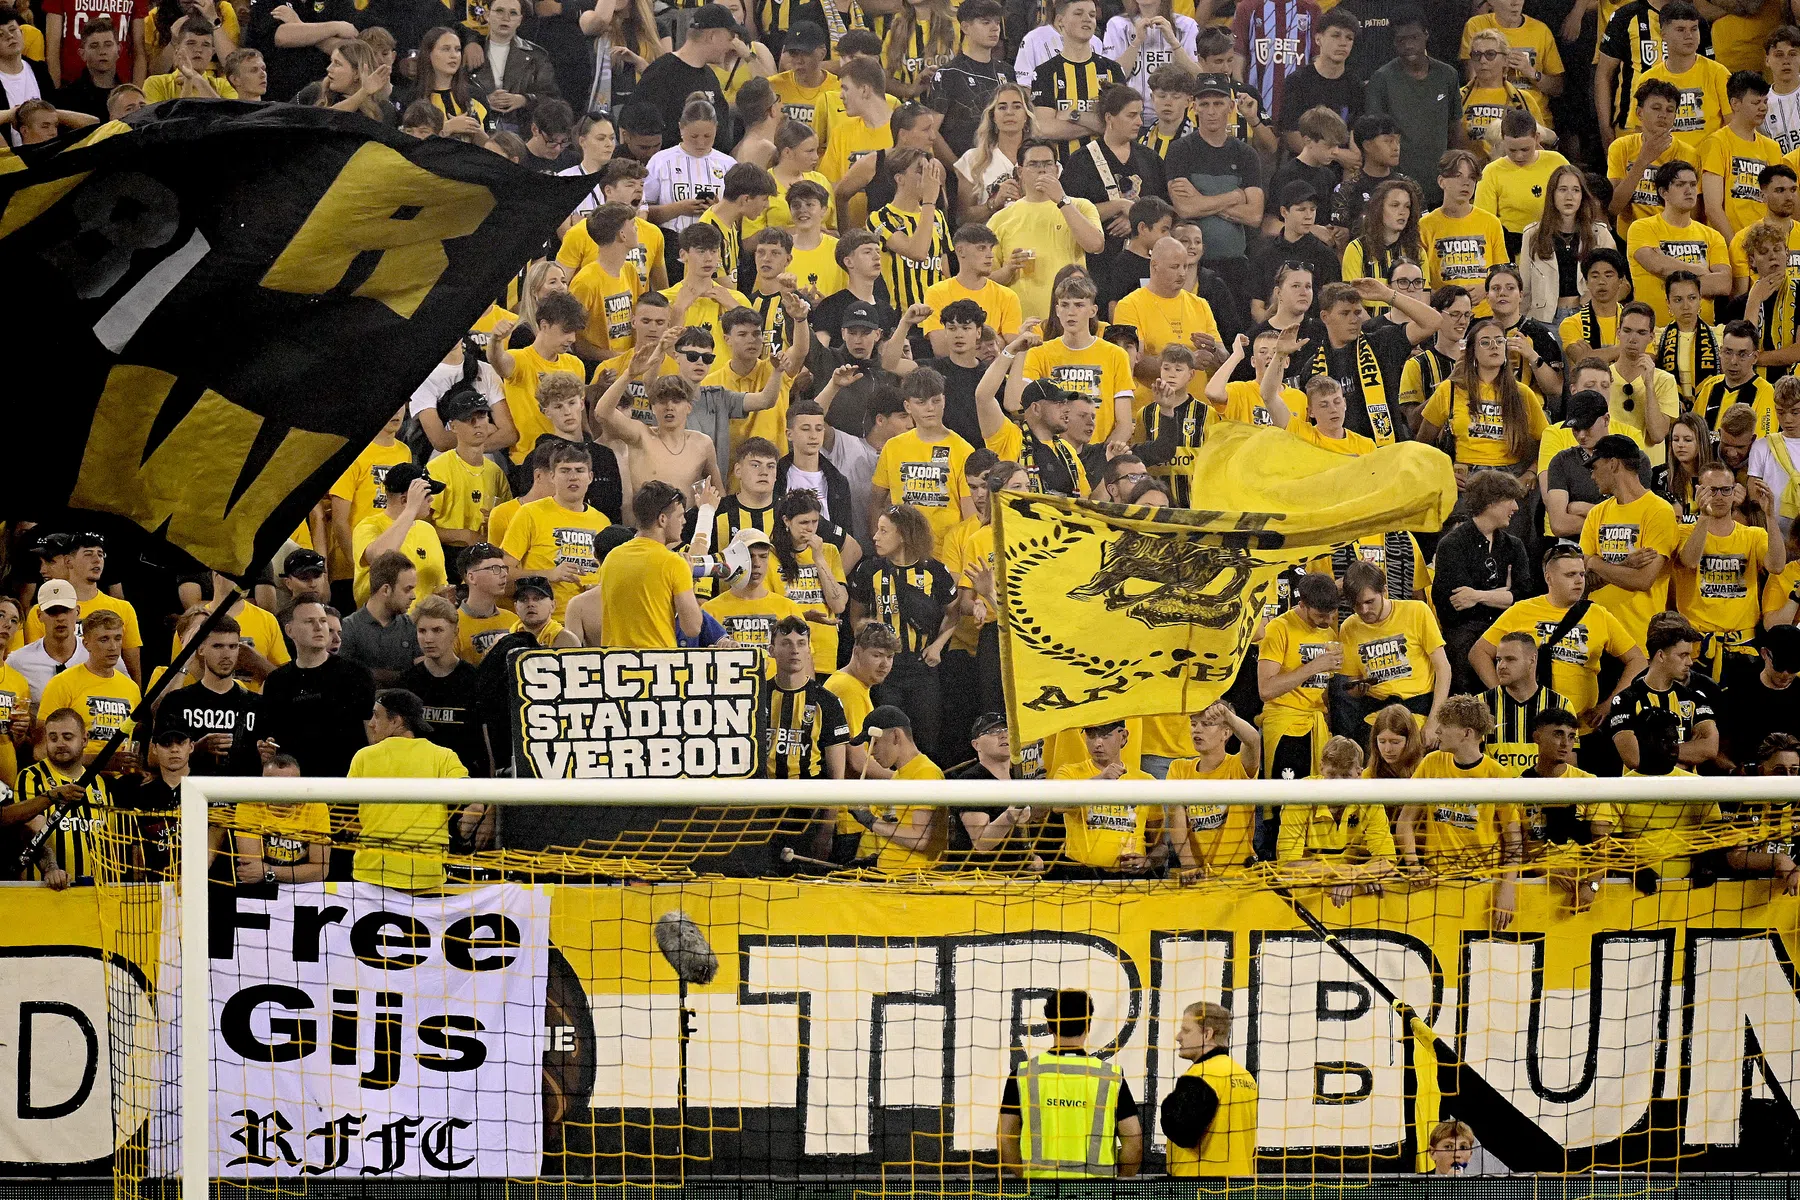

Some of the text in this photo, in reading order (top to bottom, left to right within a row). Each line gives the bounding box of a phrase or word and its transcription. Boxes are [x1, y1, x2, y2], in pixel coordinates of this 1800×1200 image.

[63, 12, 131, 42] ICN
[1273, 38, 1301, 51] BET
[1273, 51, 1305, 66] CITY
[788, 105, 812, 120] VOO
[1077, 100, 1099, 112] BE
[1632, 191, 1658, 202] ZWAR
[1443, 239, 1479, 253] VOOR
[1667, 244, 1700, 256] VOOR
[763, 330, 777, 342] ET
[1060, 369, 1094, 381] VOOR
[907, 466, 941, 480] VOOR
[907, 479, 941, 492] GEEL
[561, 531, 592, 544] VOOR
[1606, 528, 1632, 540] VOOR
[1706, 557, 1740, 571] VOOR
[1704, 583, 1738, 593] ZWART
[1263, 604, 1281, 617] ET
[733, 618, 769, 631] VOOR
[1365, 640, 1399, 658] VOOR
[1368, 654, 1398, 670] GEEL
[521, 650, 754, 701] SECTIE
[95, 700, 127, 714] VOOR
[527, 700, 752, 740] STADION
[778, 728, 805, 743] BET
[776, 741, 810, 757] CITY
[529, 736, 753, 778] VERBOD
[1092, 814, 1129, 827] ZWART
[1767, 841, 1796, 856] BET
[207, 883, 522, 972] Free
[220, 983, 489, 1091] Gijs
[1046, 1098, 1088, 1109] SERVICE
